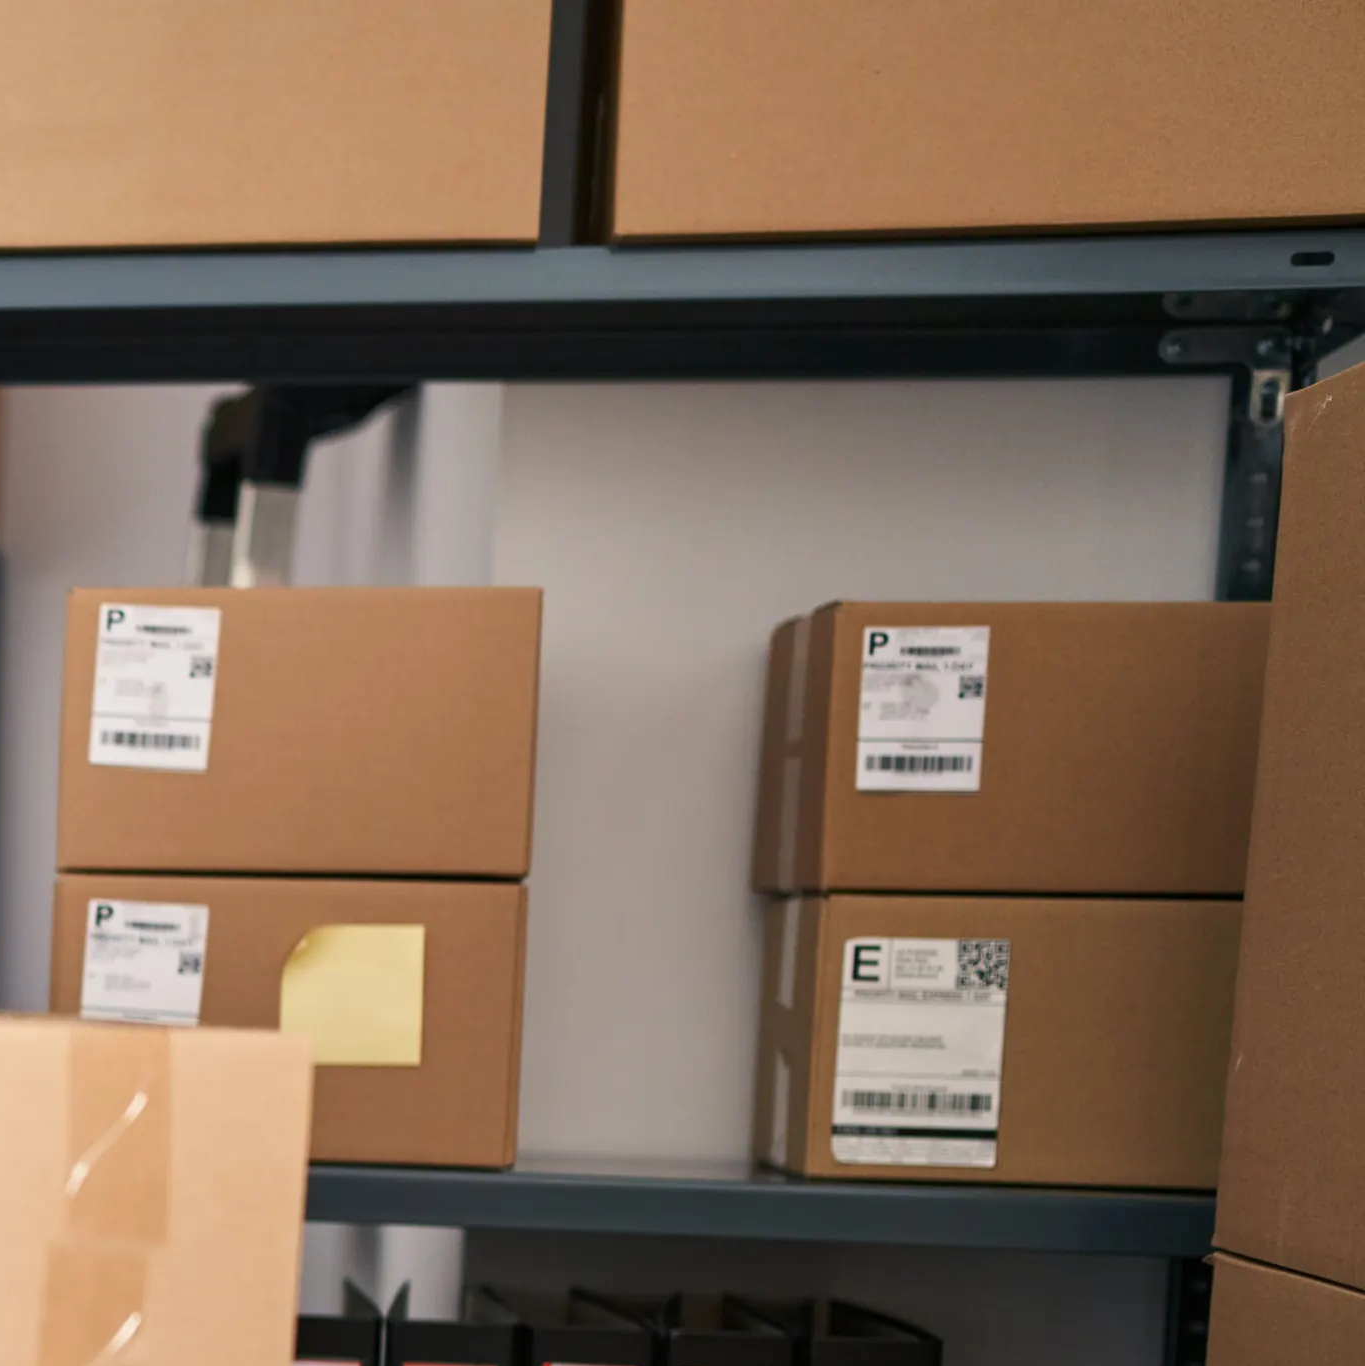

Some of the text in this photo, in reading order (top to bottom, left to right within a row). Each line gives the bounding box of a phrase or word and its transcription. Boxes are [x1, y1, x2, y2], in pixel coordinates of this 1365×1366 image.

[107, 609, 125, 632] P
[869, 631, 889, 656] P
[95, 903, 115, 928] P
[852, 944, 882, 983] E
